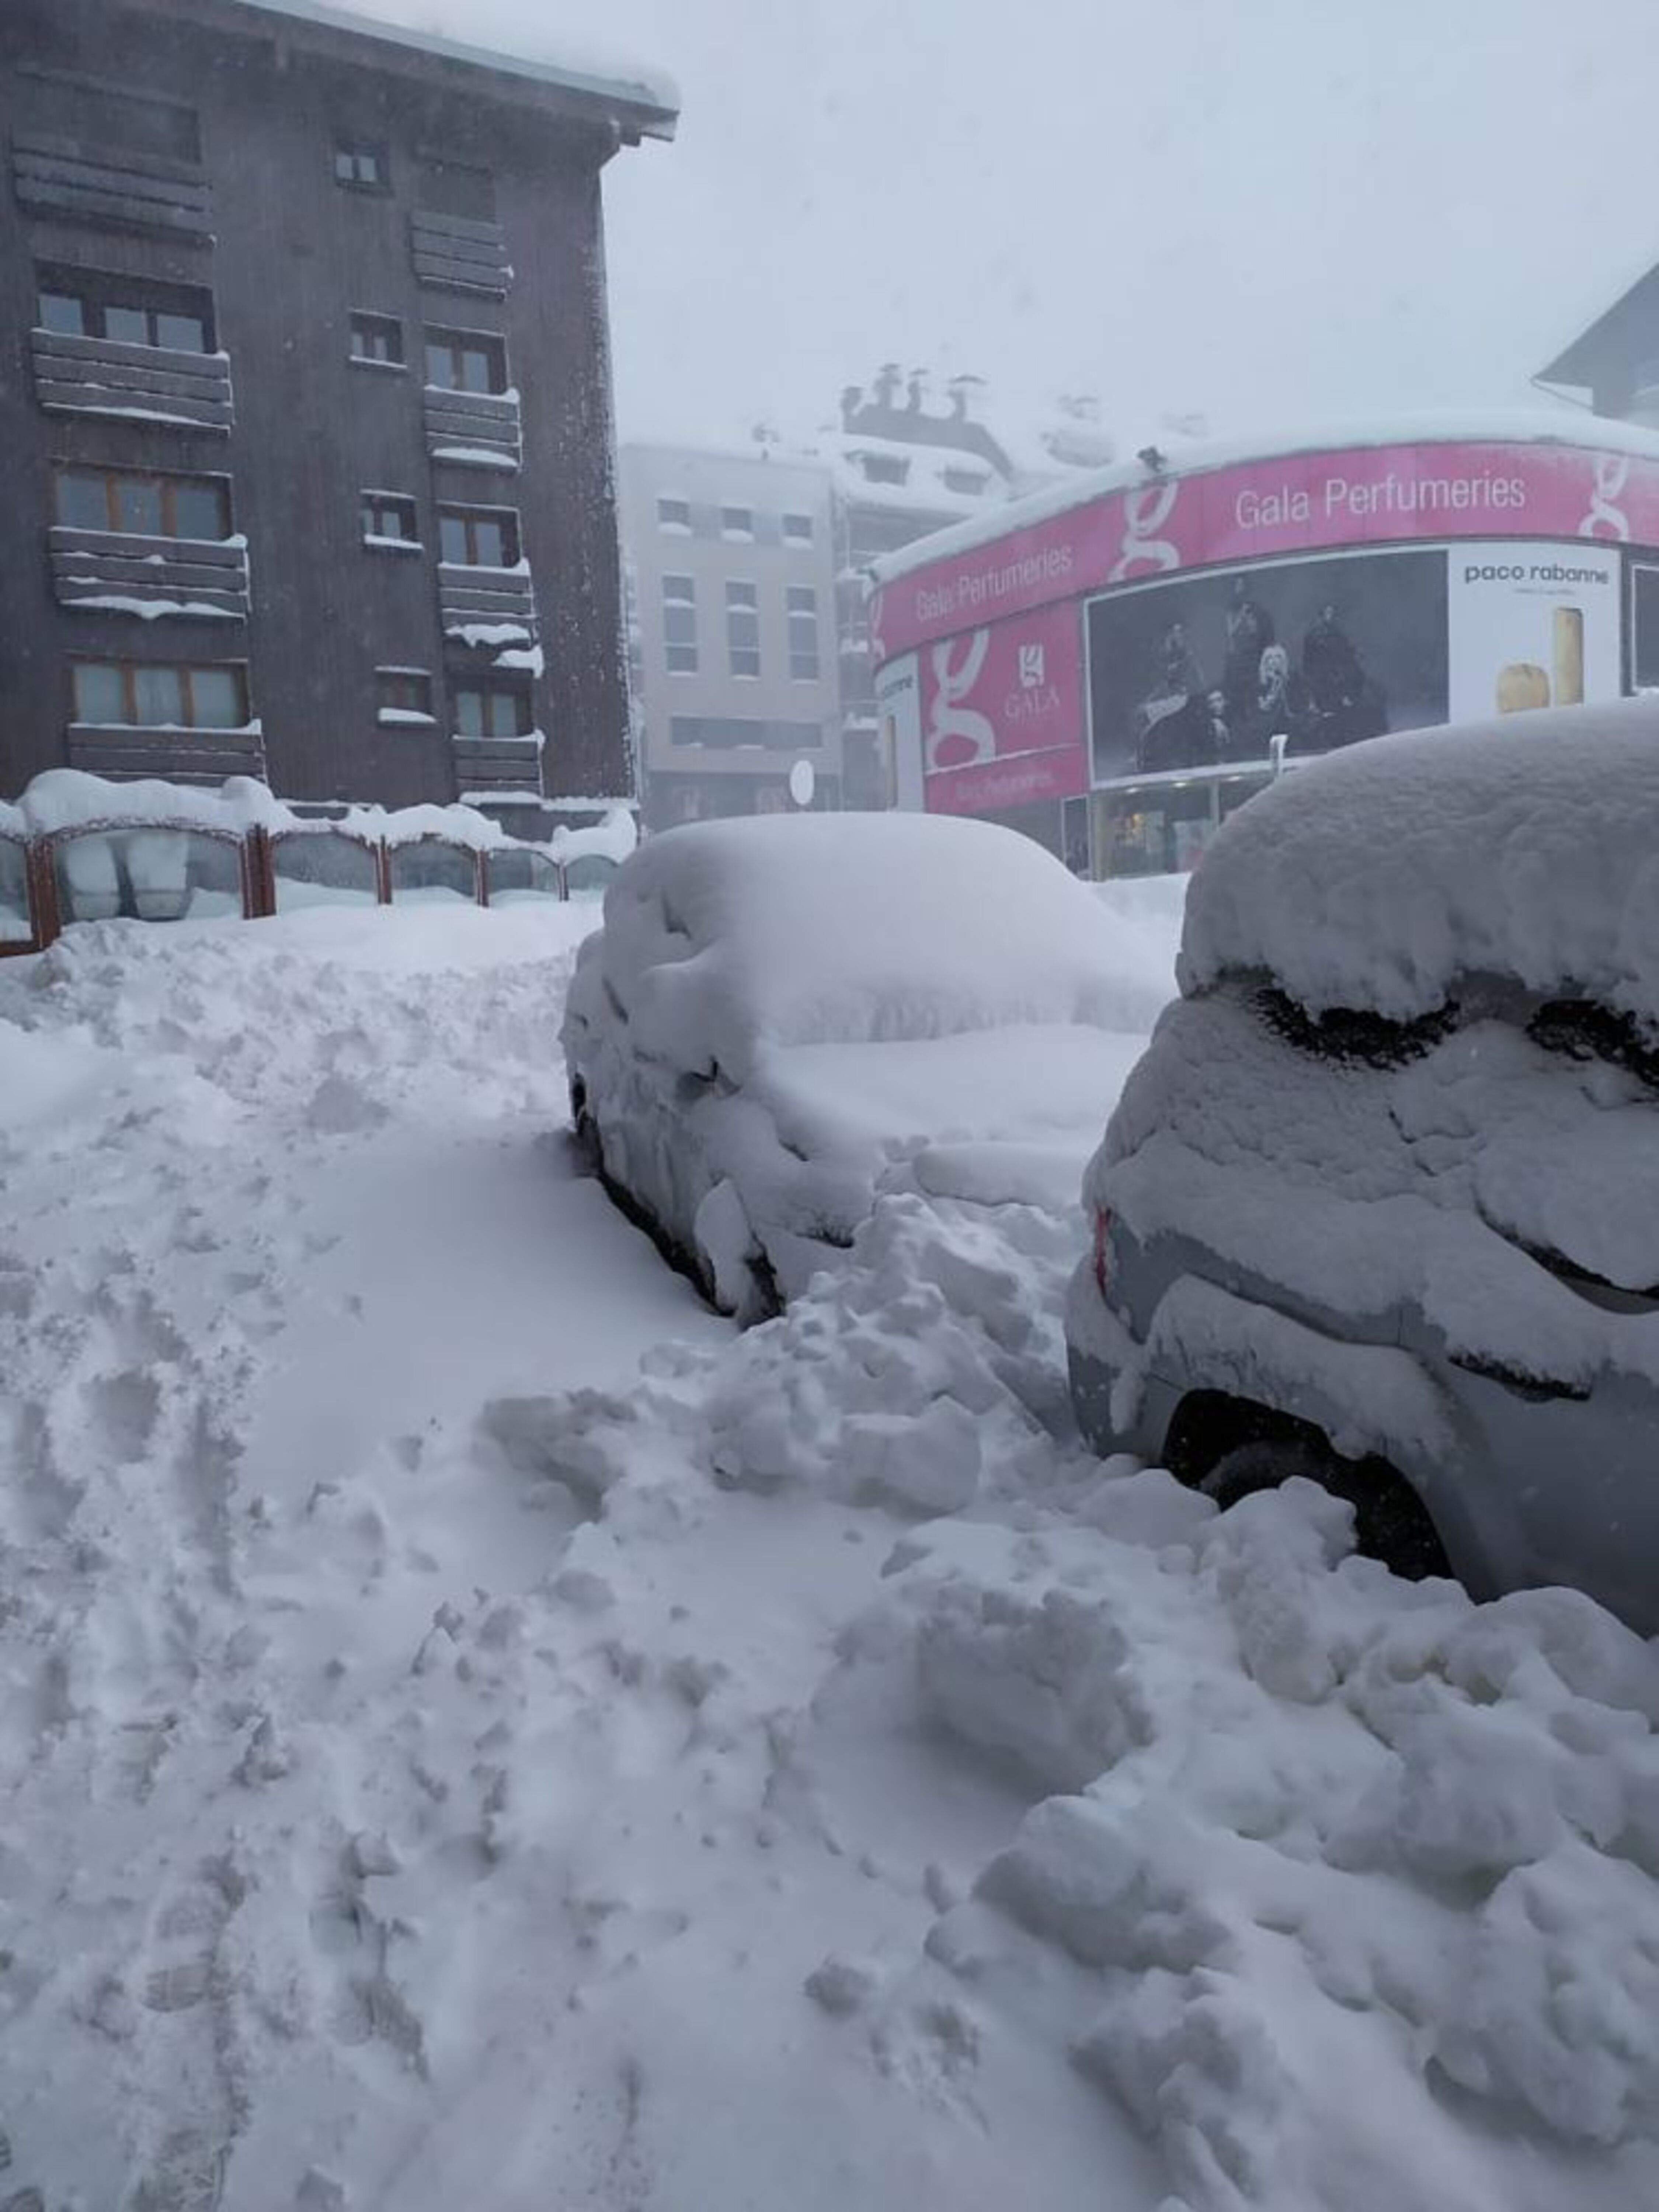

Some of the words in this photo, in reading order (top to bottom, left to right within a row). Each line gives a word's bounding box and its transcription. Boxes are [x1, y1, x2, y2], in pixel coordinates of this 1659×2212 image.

[1235, 484, 1310, 529] Gala
[1326, 470, 1525, 516] Perfumeries
[916, 583, 954, 622] Gala
[958, 545, 1074, 605] Perfumeries
[1464, 565, 1524, 585] paco
[1530, 563, 1609, 585] rabanne
[1004, 685, 1061, 723] GALA
